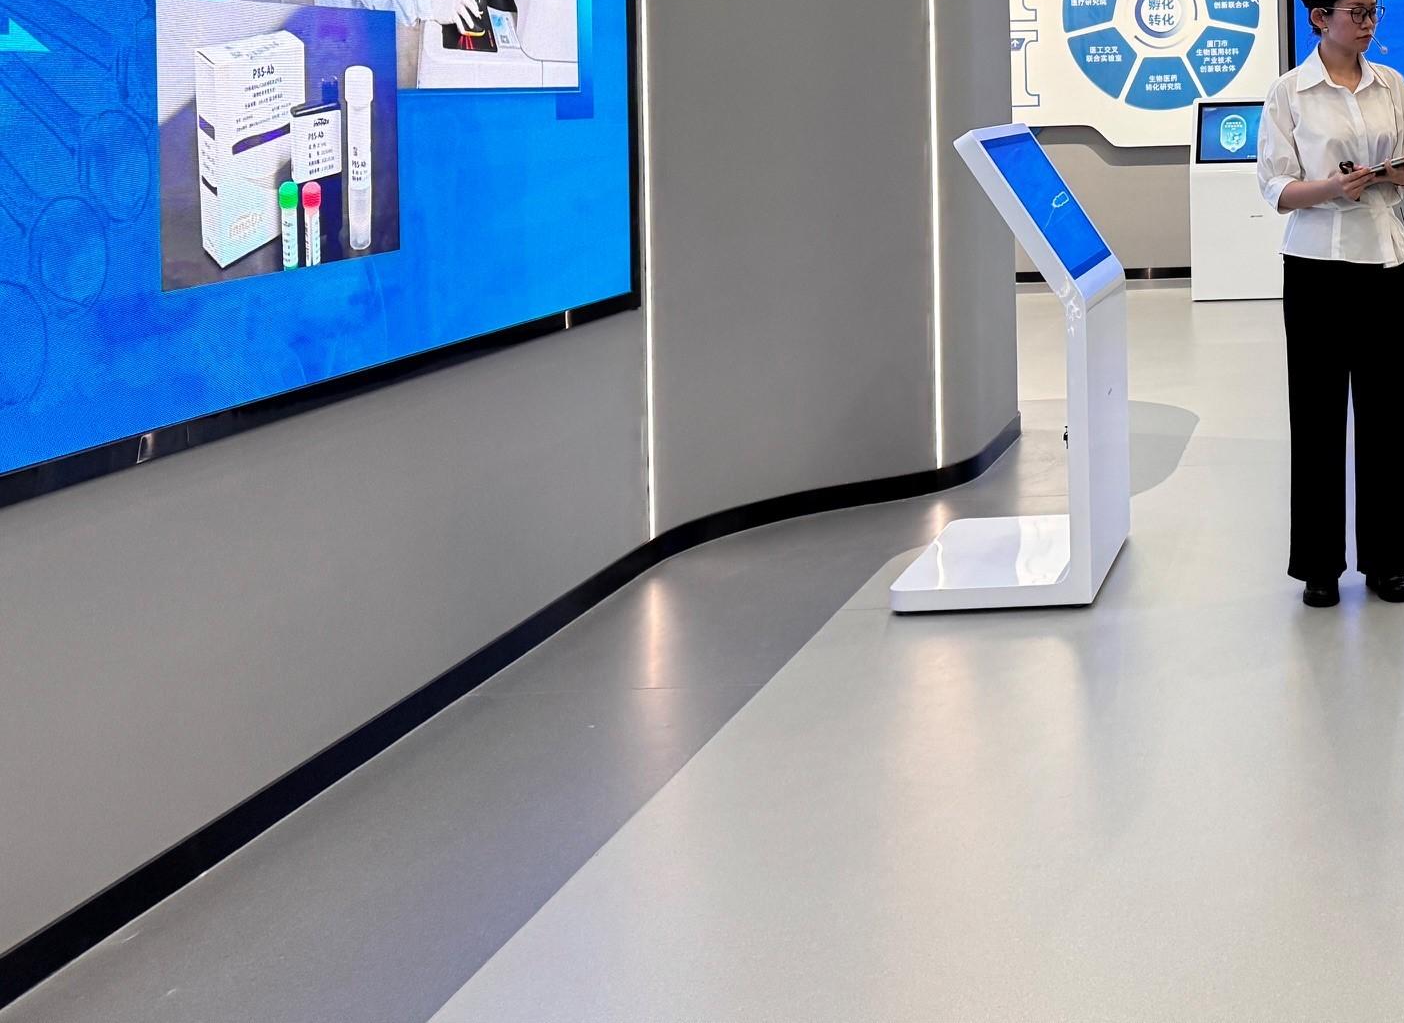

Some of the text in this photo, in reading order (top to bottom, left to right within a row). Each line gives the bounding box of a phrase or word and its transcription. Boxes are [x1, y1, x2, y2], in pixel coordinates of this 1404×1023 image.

[1148, 13, 1175, 26] 转化
[1089, 46, 1119, 54] 医工交叉
[1203, 57, 1233, 65] 产业技术
[1148, 74, 1178, 82] 生物医药
